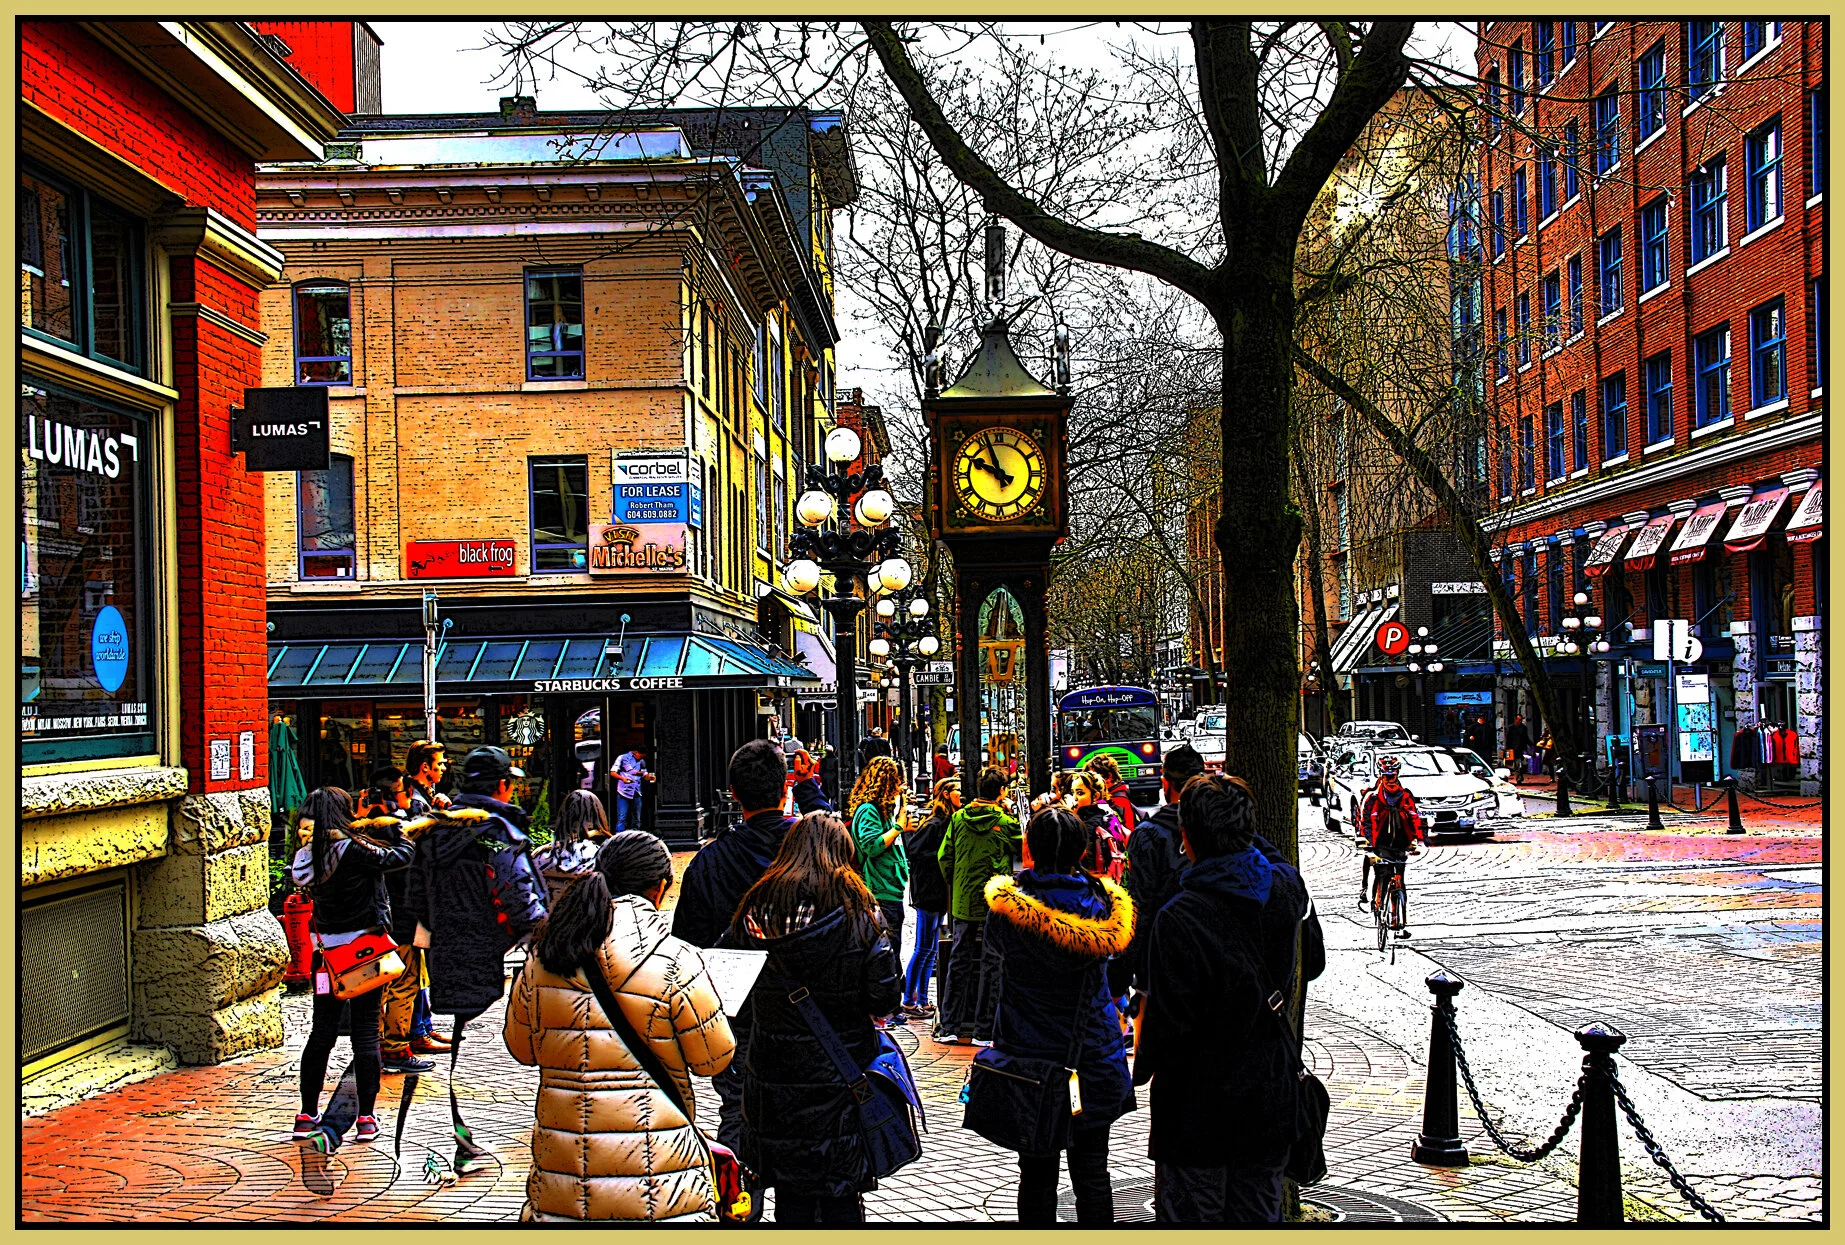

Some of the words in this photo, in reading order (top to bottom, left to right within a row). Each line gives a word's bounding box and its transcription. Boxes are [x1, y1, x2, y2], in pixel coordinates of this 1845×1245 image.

[252, 423, 308, 437] LUMAS
[29, 414, 120, 478] LUMAS
[628, 461, 682, 475] corbel
[621, 486, 644, 497] FOR
[646, 485, 681, 497] LEASE
[630, 501, 654, 509] Robert
[627, 510, 677, 519] 604.609.0882
[604, 529, 638, 541] VISIT
[459, 542, 489, 563] black
[490, 541, 513, 567] frog
[592, 544, 684, 567] Michelle's
[99, 634, 108, 643] we
[109, 630, 121, 646] ship
[1385, 627, 1402, 649] P
[96, 648, 126, 661] worldwide
[534, 679, 620, 692] STARBUCKS
[629, 677, 683, 690] COFFEE
[916, 674, 940, 683] CAMBIE
[121, 703, 147, 714] LUMAS.COM
[37, 718, 51, 730] MILAN
[53, 717, 72, 730] MOSCOW
